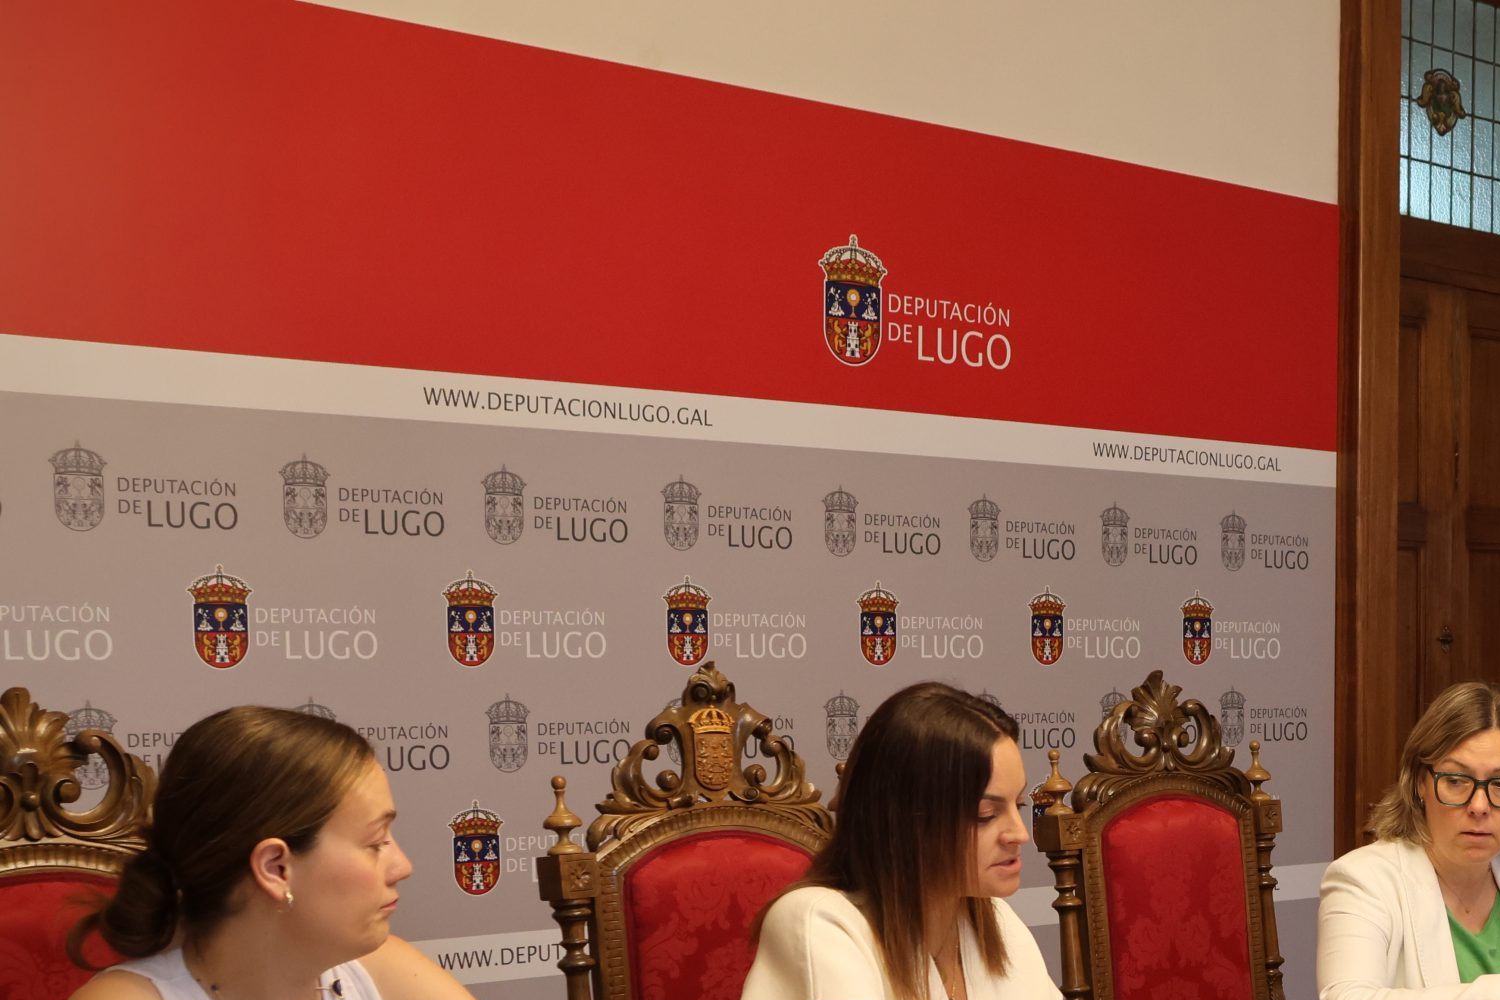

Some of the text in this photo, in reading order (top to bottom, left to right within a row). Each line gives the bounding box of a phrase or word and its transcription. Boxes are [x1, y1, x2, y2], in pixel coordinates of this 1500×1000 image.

[888, 292, 1011, 328] DEPUTACIÓN
[888, 322, 1011, 370] DE LUGO
[423, 386, 712, 428] WWW.DEPUTACIONLUGO.GAL
[1093, 441, 1281, 472] WWW.DEPUTACIONLUGO.GAL
[117, 476, 238, 497] DEPUTACIÓN
[338, 487, 444, 506] DEPUTACIÓN
[118, 499, 239, 530] DE LUGO
[533, 496, 628, 514] DEPUTACIÓN
[707, 504, 792, 523] DEPUTACIÓN
[339, 508, 445, 538] DE LUGO
[534, 516, 629, 544] DE LUGO
[864, 512, 941, 530] DEPUTACIÓN
[1006, 519, 1075, 536] DEPUTACIÓN
[707, 523, 793, 551] DE LUGO
[864, 531, 941, 556] DE LUGO
[1134, 525, 1197, 542] DEPUTACIÓN
[1251, 532, 1309, 549] DEPUTACIÓN
[1006, 536, 1076, 561] DE LUGO
[1134, 542, 1198, 566] DE LUGO
[1251, 548, 1309, 571] DE LUGO
[0, 602, 110, 623] PUTACIÓN
[255, 607, 377, 626] DEPUTACIÓN
[500, 607, 606, 627] DEPUTACIÓN
[713, 611, 806, 630] DEPUTACIÓN
[901, 615, 984, 631] DEPUTACIÓN
[1067, 617, 1140, 633] DEPUTACIÓN
[1214, 620, 1281, 634] DEPUTACIÓN
[4, 629, 113, 661] LUGO
[256, 631, 378, 661] DE LUGO
[501, 631, 607, 660] DE LUGO
[714, 633, 807, 660] DE LUGO
[901, 634, 984, 660] DE LUGO
[1067, 635, 1141, 660] DE LUGO
[1214, 637, 1281, 660] DE LUGO
[1250, 706, 1308, 719] DEPUTACIÓN
[537, 718, 631, 736] DEPUTACIÓN
[1022, 726, 1076, 750] LUGO
[1250, 722, 1308, 742] DE LUGO
[386, 744, 450, 772] UGO
[538, 739, 631, 765] DE LUGO
[506, 857, 528, 873] DE
